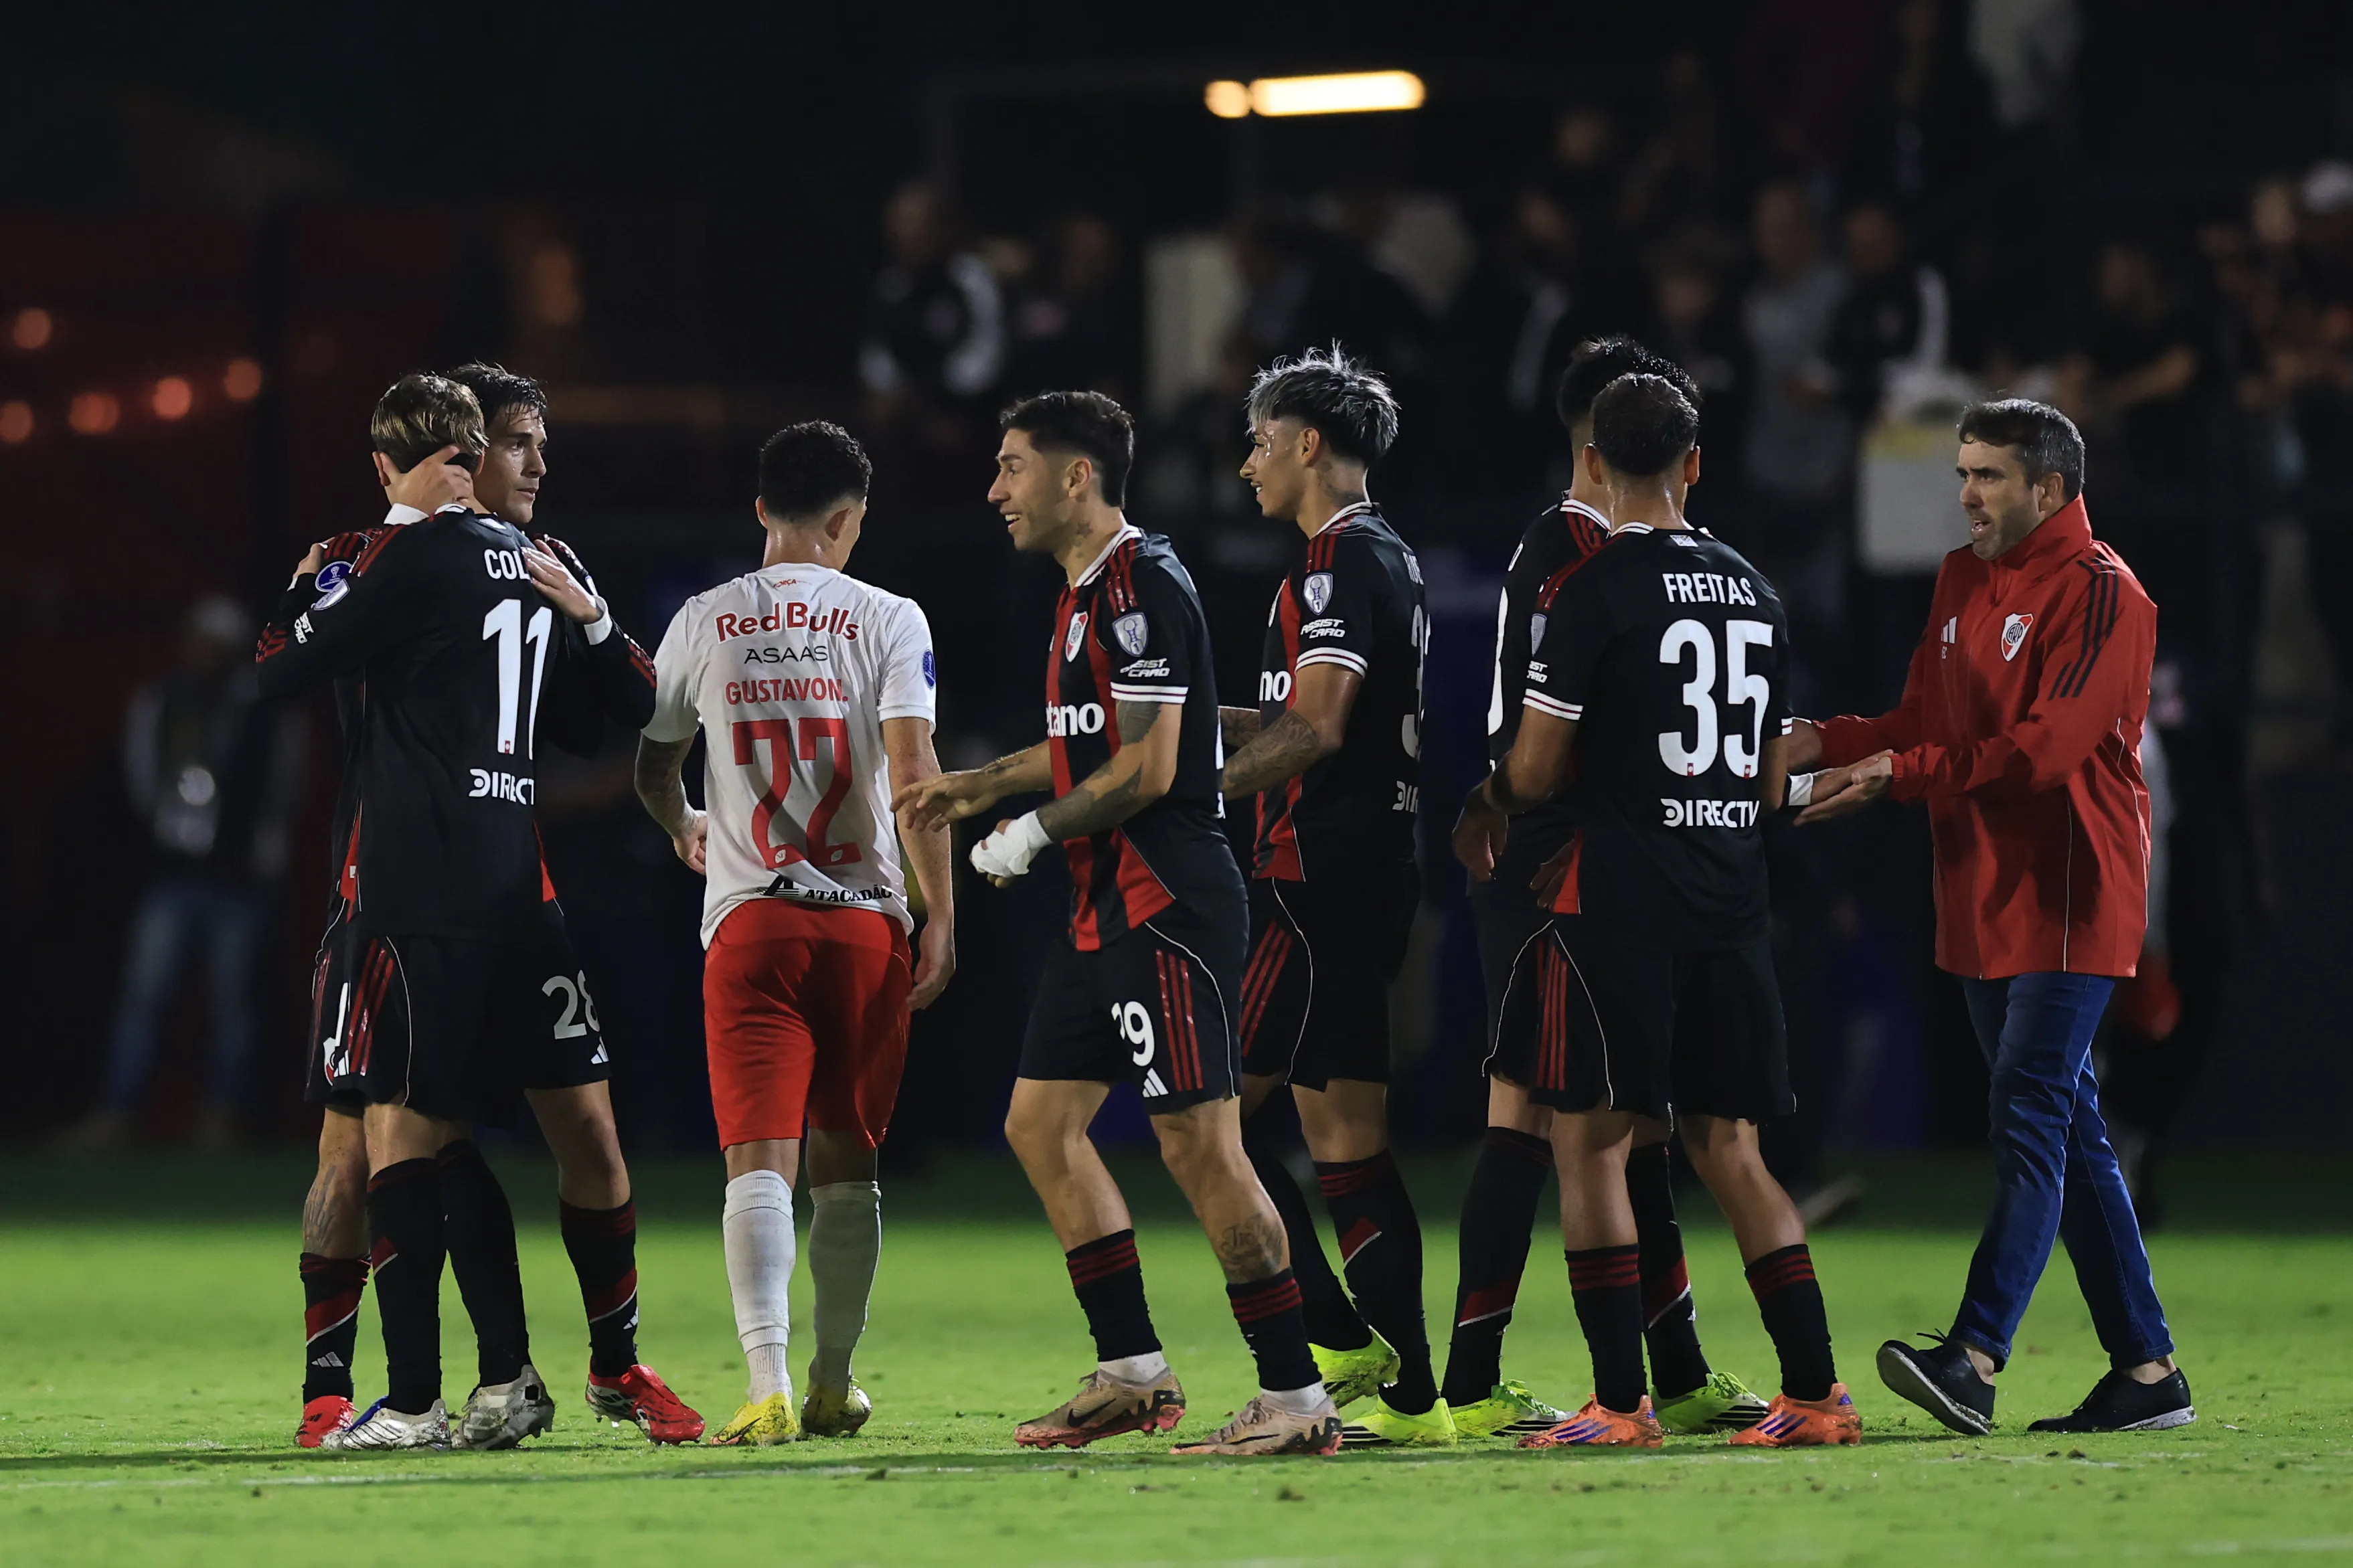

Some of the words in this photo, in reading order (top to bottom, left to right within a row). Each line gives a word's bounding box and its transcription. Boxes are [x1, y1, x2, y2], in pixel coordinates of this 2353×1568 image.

[1662, 573, 1757, 606] FREITAS
[716, 602, 781, 642] Red
[787, 602, 860, 640] Bulls
[1309, 628, 1346, 639] CARD
[744, 645, 829, 665] ASAAS
[482, 598, 552, 760] 11
[1259, 671, 1292, 702] no
[1658, 618, 1774, 778] 35
[1046, 700, 1105, 737] tano
[732, 717, 862, 869] 22
[1660, 798, 1760, 828] DIRECTV
